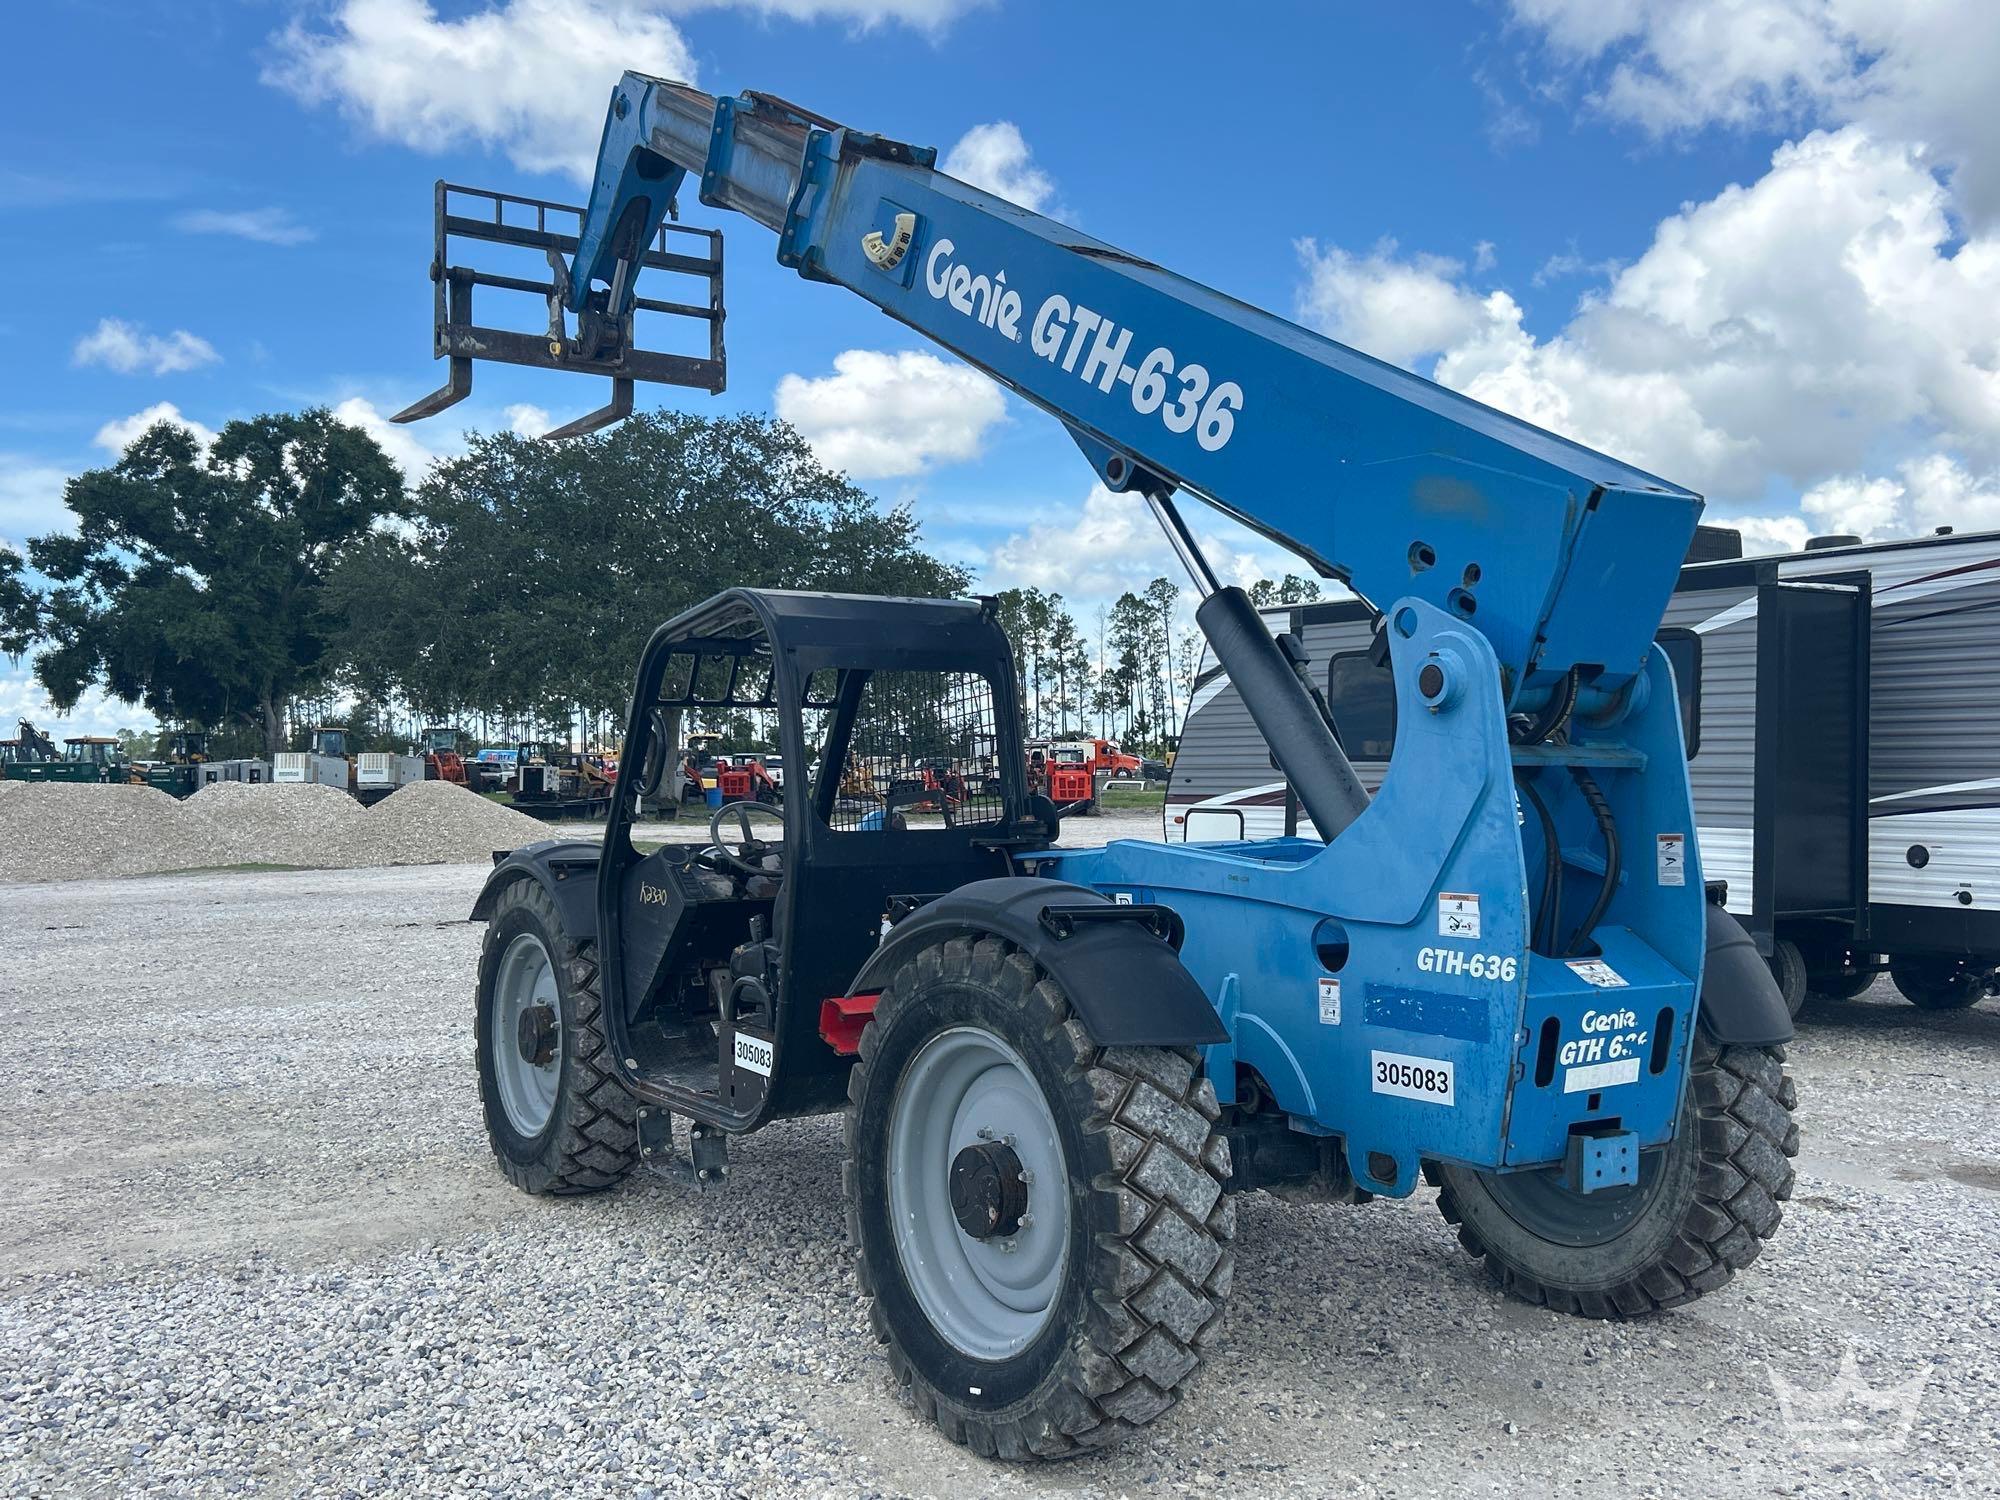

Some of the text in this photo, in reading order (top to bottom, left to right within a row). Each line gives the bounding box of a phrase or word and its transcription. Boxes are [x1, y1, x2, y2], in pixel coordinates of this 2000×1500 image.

[900, 232, 911, 244] 80
[926, 238, 1243, 452] Genie GTH-636
[1417, 947, 1517, 982] GTH-636
[1581, 1008, 1636, 1034] Genie
[736, 1040, 771, 1069] 305083
[1559, 1037, 1606, 1065] GTH
[1377, 1061, 1449, 1095] 305083
